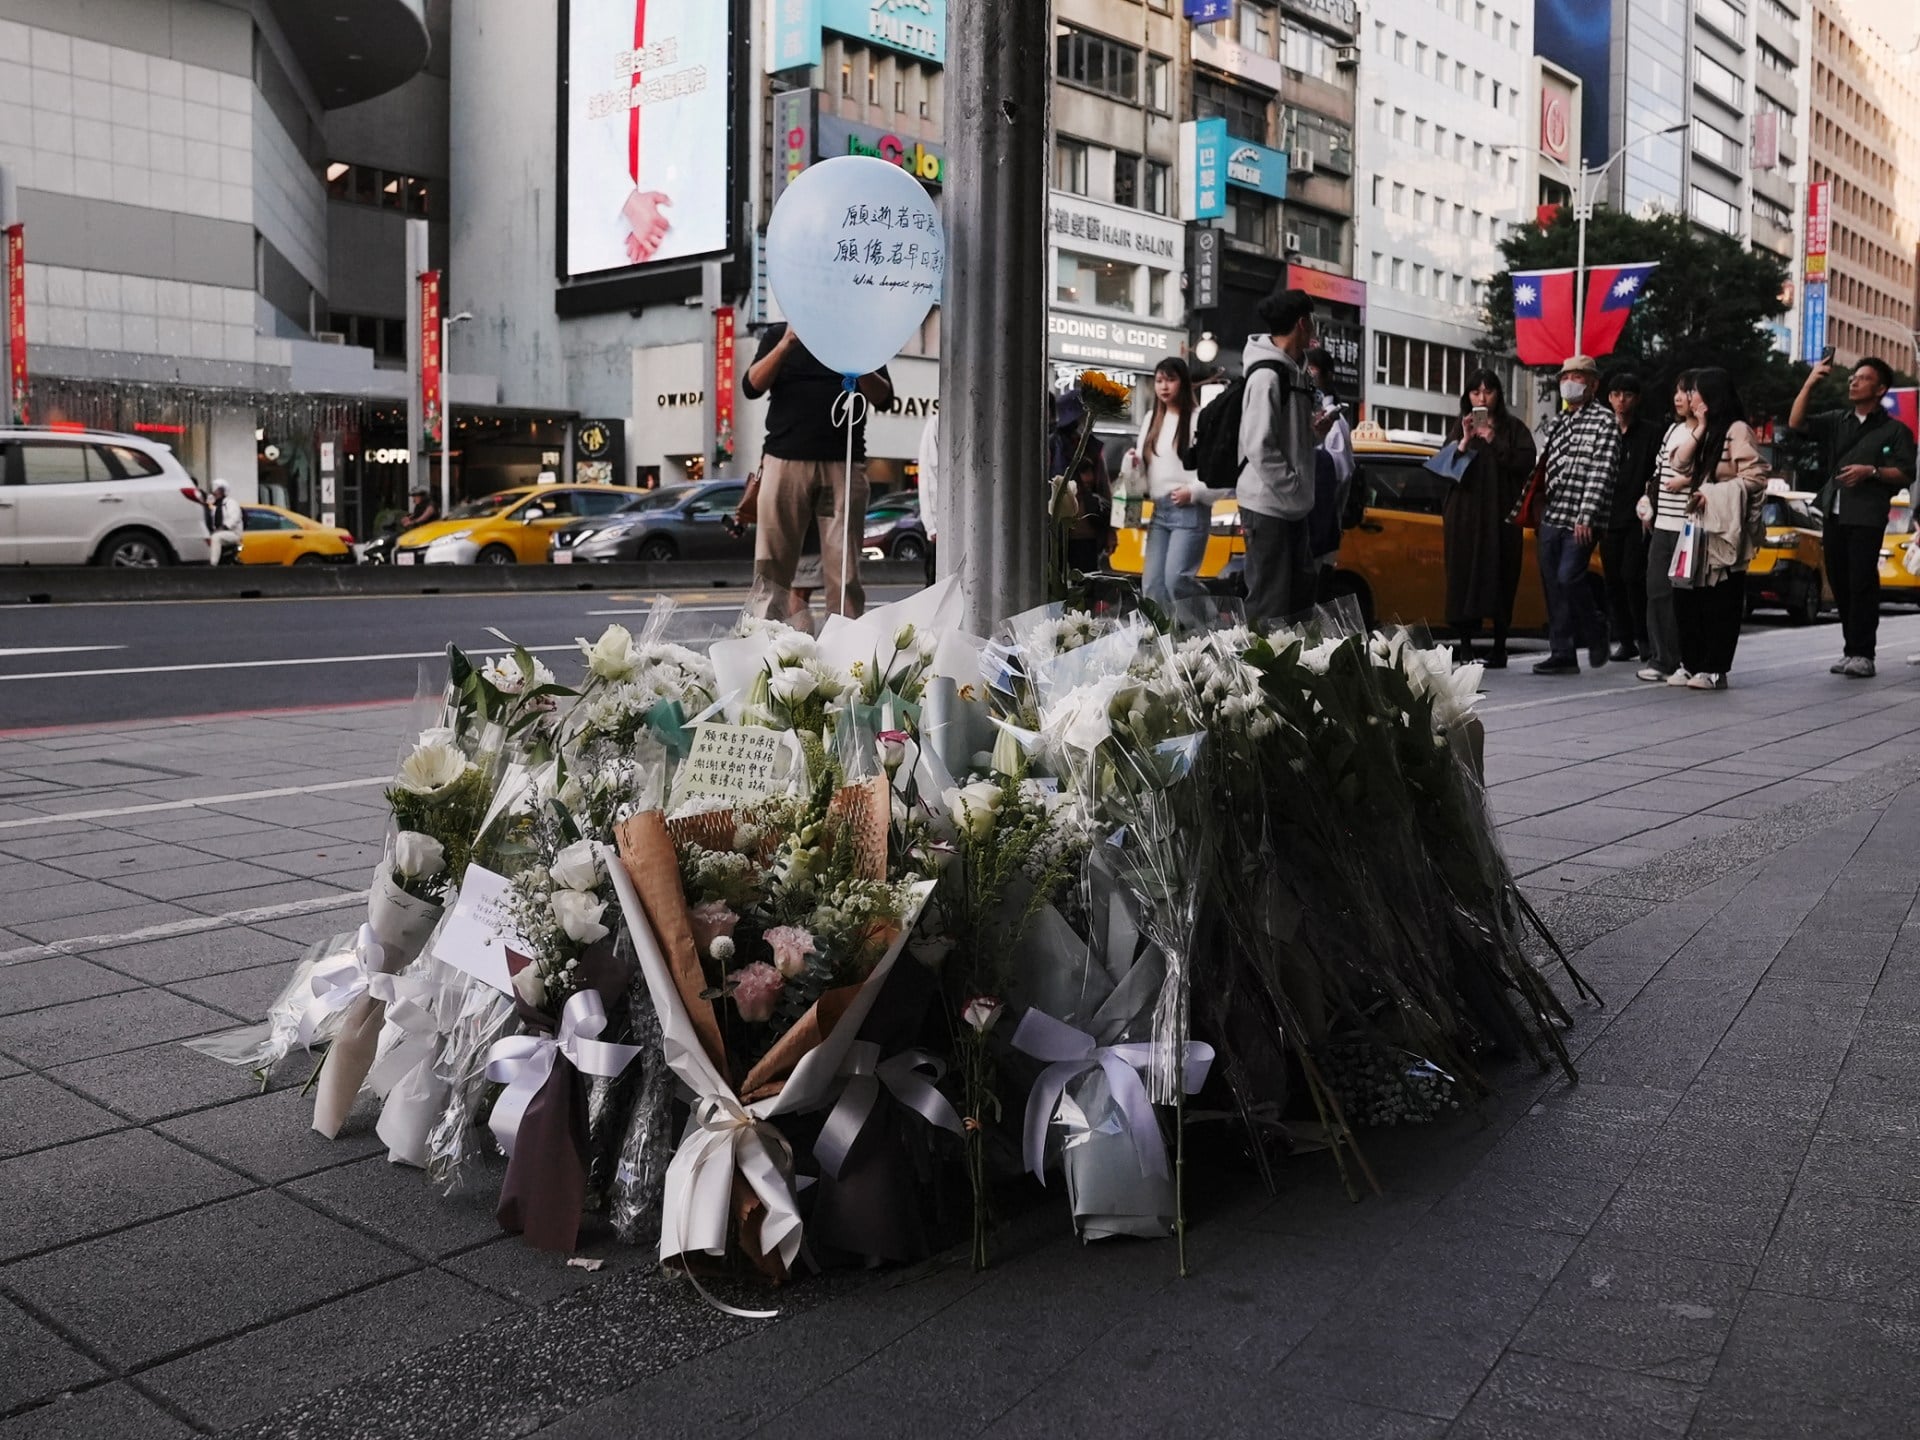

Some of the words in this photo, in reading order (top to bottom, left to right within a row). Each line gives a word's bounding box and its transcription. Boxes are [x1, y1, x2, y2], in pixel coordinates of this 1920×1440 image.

[1203, 3, 1217, 17] 2F
[869, 12, 937, 57] PALETTE
[1102, 224, 1132, 249] HAIR
[1135, 232, 1174, 258] SALON
[1127, 329, 1167, 350] CODE
[874, 396, 940, 417] DAYS
